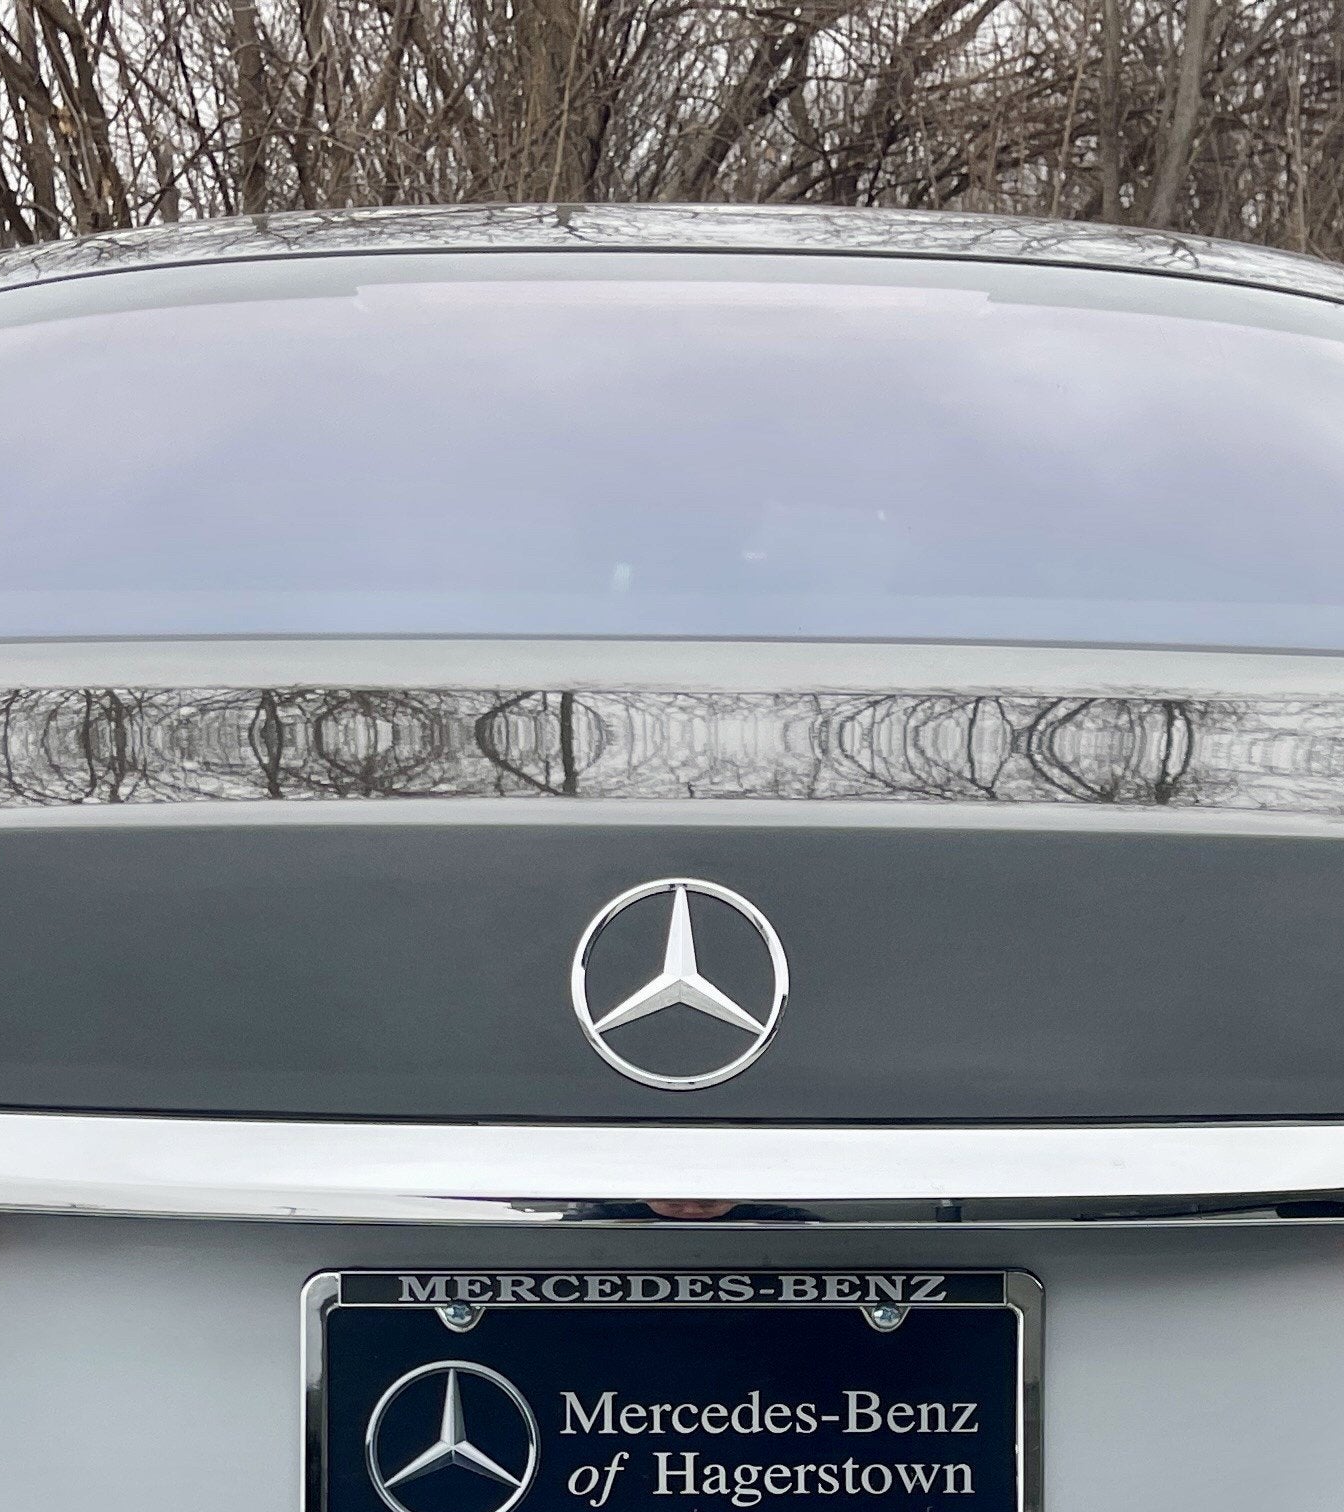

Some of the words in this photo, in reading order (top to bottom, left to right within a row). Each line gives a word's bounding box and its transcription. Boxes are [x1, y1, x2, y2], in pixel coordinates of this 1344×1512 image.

[399, 1275, 947, 1303] MERCEDES-BENZ
[559, 1390, 979, 1435] Mercedes-Benz
[567, 1451, 630, 1508] of
[652, 1452, 975, 1508] Hagerstown
